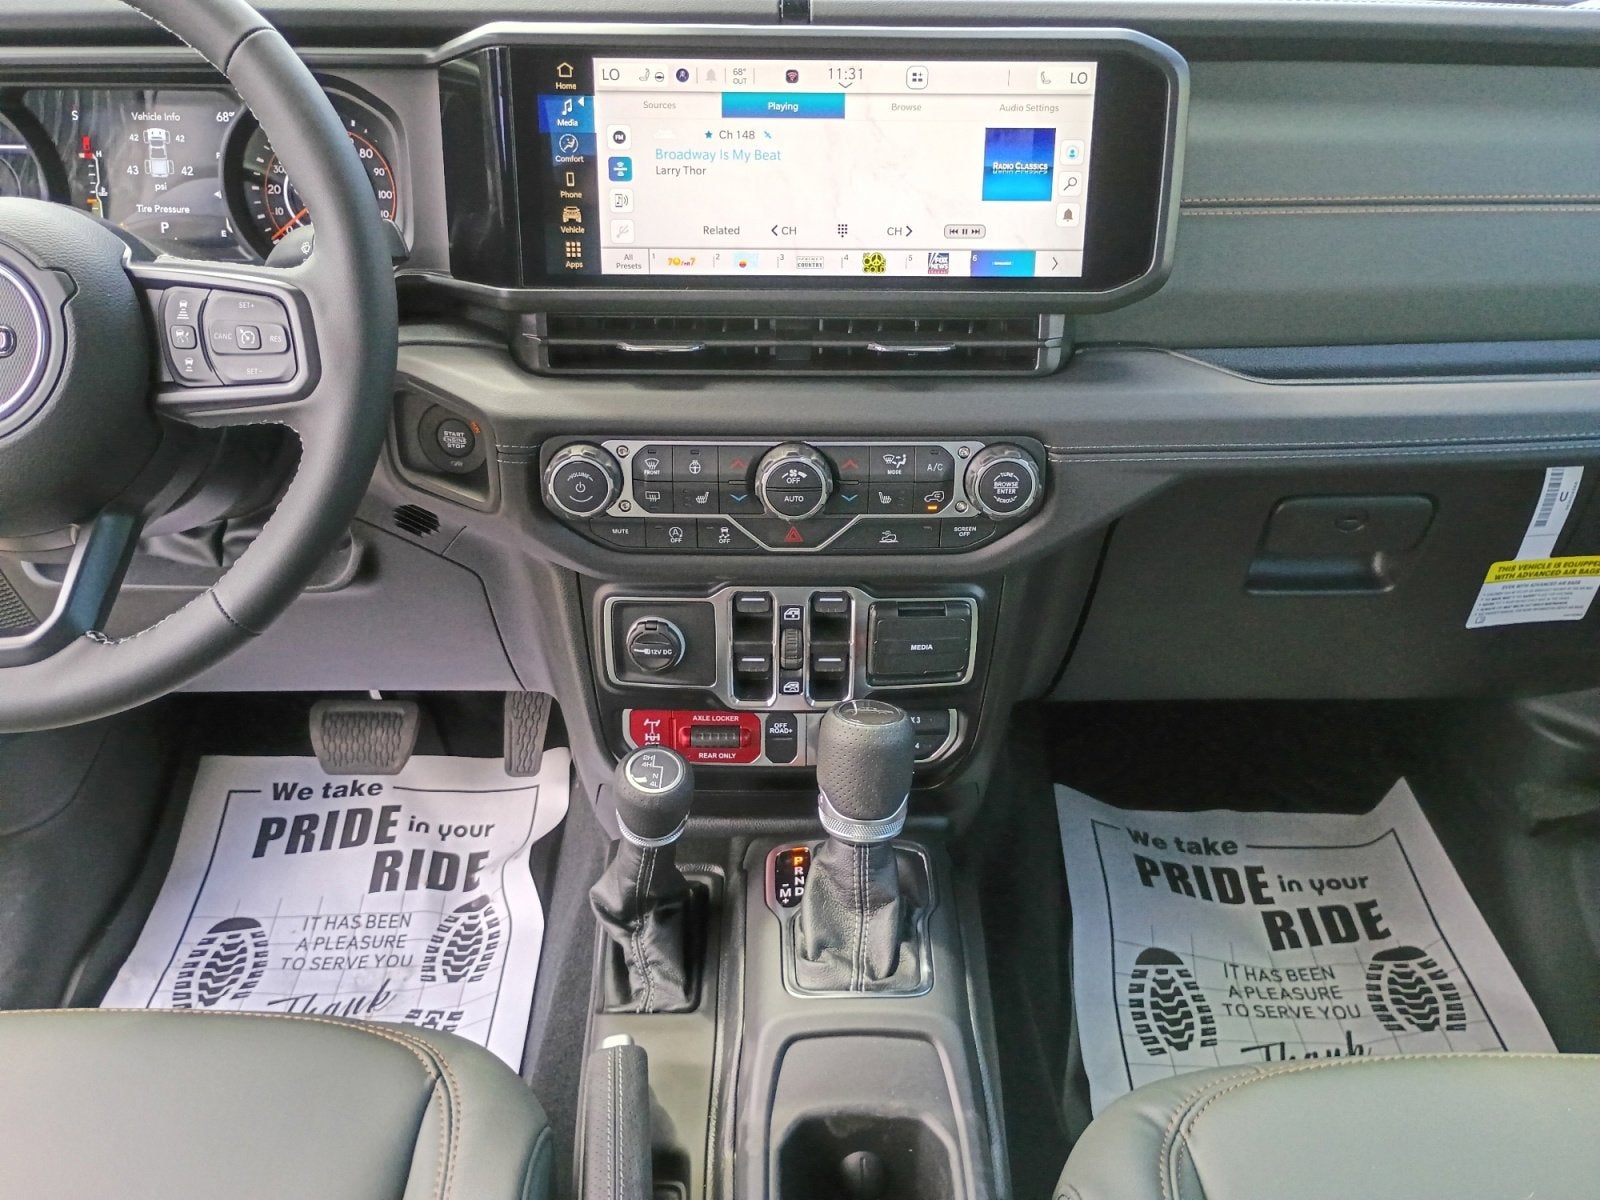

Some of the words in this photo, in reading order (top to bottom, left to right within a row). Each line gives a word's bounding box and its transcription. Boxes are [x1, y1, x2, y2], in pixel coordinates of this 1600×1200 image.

[602, 69, 620, 80] LO
[828, 68, 864, 80] 11:31
[1070, 72, 1088, 84] LO
[555, 82, 577, 91] Home
[643, 100, 677, 110] Sources
[767, 101, 799, 113] Playing
[891, 103, 922, 111] Browse
[999, 104, 1023, 112] Audio
[1025, 104, 1060, 114] Settings
[131, 112, 162, 121] Vehicle
[164, 112, 181, 121] Info
[557, 118, 579, 127] Media
[175, 134, 185, 143] 42
[719, 130, 733, 139] Ch
[736, 130, 755, 139] 148
[360, 148, 373, 158] 80
[655, 149, 717, 163] Broadway
[720, 149, 730, 160] Is
[732, 149, 751, 163] My
[754, 149, 781, 160] Beat
[555, 154, 584, 163] Comfort
[127, 166, 139, 175] 43
[181, 166, 194, 175] 42
[373, 168, 385, 176] 90
[655, 166, 681, 177] Larry
[682, 166, 706, 175] Thor
[155, 182, 167, 191] psi
[268, 184, 281, 194] 20
[378, 190, 392, 199] 100
[560, 190, 582, 199] Phone
[136, 205, 152, 213] Tire
[154, 205, 190, 214] Pressure
[275, 207, 284, 215] 10
[161, 222, 169, 233] P
[560, 225, 585, 234] Vehicle
[703, 225, 740, 235] Related
[781, 227, 797, 235] CH
[887, 227, 902, 236] CH
[624, 253, 633, 261] All
[565, 261, 583, 269] Apps
[616, 262, 642, 270] Presets
[213, 332, 232, 340] CANC
[269, 335, 282, 343] RES
[926, 463, 943, 471] A/C
[1519, 562, 1553, 570] VEHICLE
[1517, 570, 1561, 578] ADVANCED
[272, 782, 314, 800] We
[322, 780, 384, 799] take
[252, 805, 402, 858] PRIDE
[408, 815, 430, 833] in
[438, 823, 495, 841] your
[1126, 827, 1167, 850] We
[1173, 836, 1238, 856] take
[794, 856, 803, 865] P
[368, 849, 490, 894] RIDE
[794, 866, 804, 875] R
[794, 876, 804, 885] N
[1133, 853, 1275, 905] PRIDE
[1277, 875, 1303, 892] in
[1309, 875, 1368, 895] your
[780, 888, 791, 898] M
[794, 887, 804, 896] D
[303, 916, 322, 931] IT
[326, 915, 361, 931] HAS
[366, 913, 412, 929] BEEN
[1261, 899, 1392, 951] RIDE
[295, 938, 309, 951] A
[313, 934, 407, 951] PLEASURE
[281, 957, 305, 970] TO
[309, 955, 369, 970] SERVE
[375, 954, 413, 968] YOU
[1223, 963, 1241, 979] IT
[1245, 965, 1283, 983] HAS
[1286, 966, 1335, 982] BEEN
[1229, 985, 1243, 999] A
[1245, 985, 1343, 1001] PLEASURE
[1222, 1003, 1249, 1017] TO
[1253, 1004, 1316, 1019] SERVE
[1318, 1004, 1361, 1020] YOU
